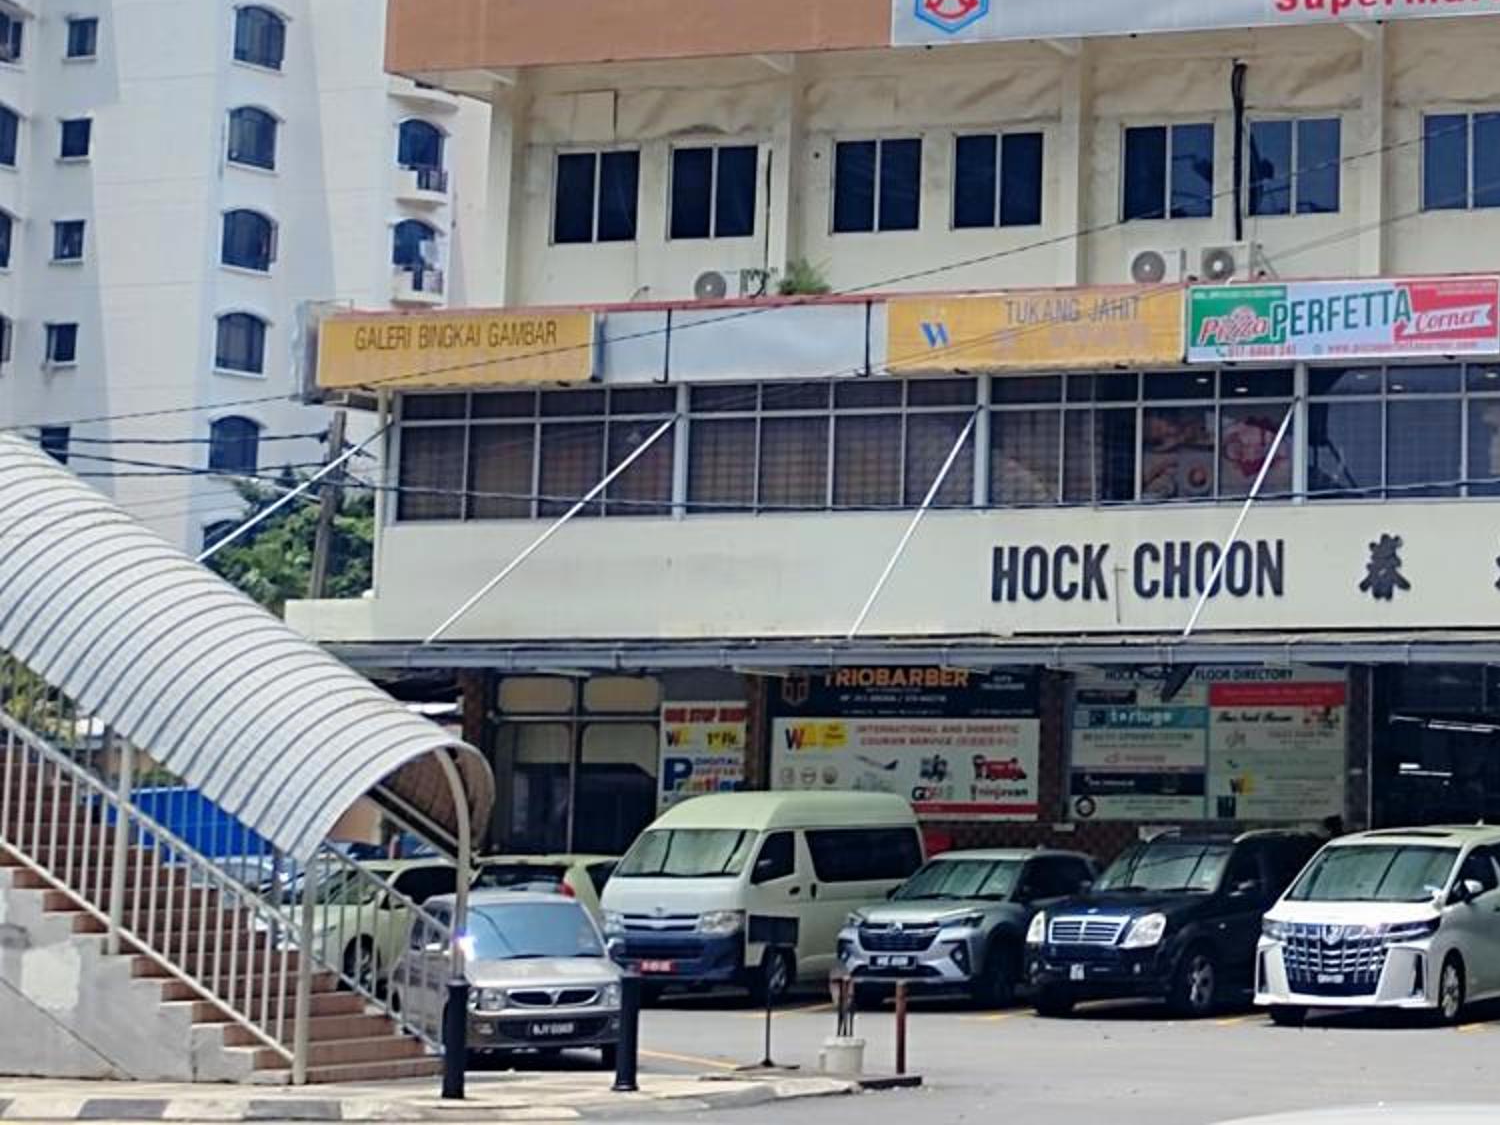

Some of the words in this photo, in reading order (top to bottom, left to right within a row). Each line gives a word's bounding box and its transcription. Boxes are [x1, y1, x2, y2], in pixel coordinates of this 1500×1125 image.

[1006, 299, 1081, 323] TUKANG
[1088, 296, 1140, 321] JAHIT
[1271, 288, 1413, 338] PERFETTA
[1414, 309, 1482, 333] Corner
[354, 325, 413, 352] GALERI
[418, 322, 481, 350] BINGKAI
[487, 319, 558, 348] GAMBAR
[992, 544, 1110, 602] HOCK
[1133, 540, 1284, 598] CHOON
